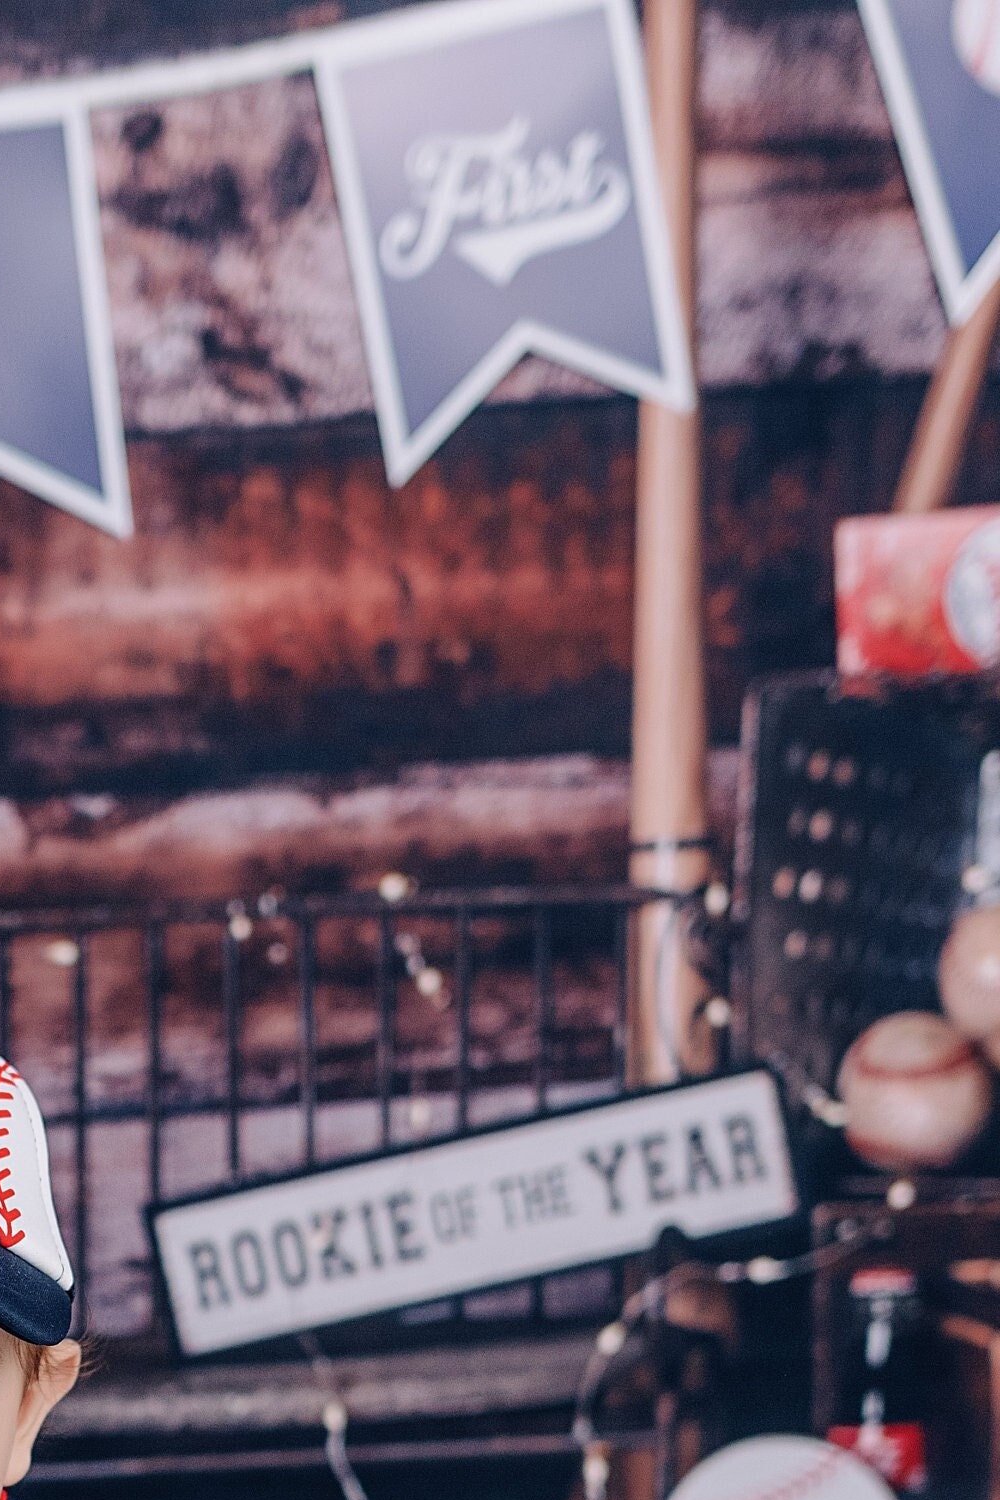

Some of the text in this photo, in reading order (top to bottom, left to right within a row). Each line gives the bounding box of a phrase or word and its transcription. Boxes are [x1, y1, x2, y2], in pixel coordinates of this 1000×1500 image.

[378, 115, 630, 287] First
[187, 1111, 770, 1312] ROOKIE OF THE YEAR
